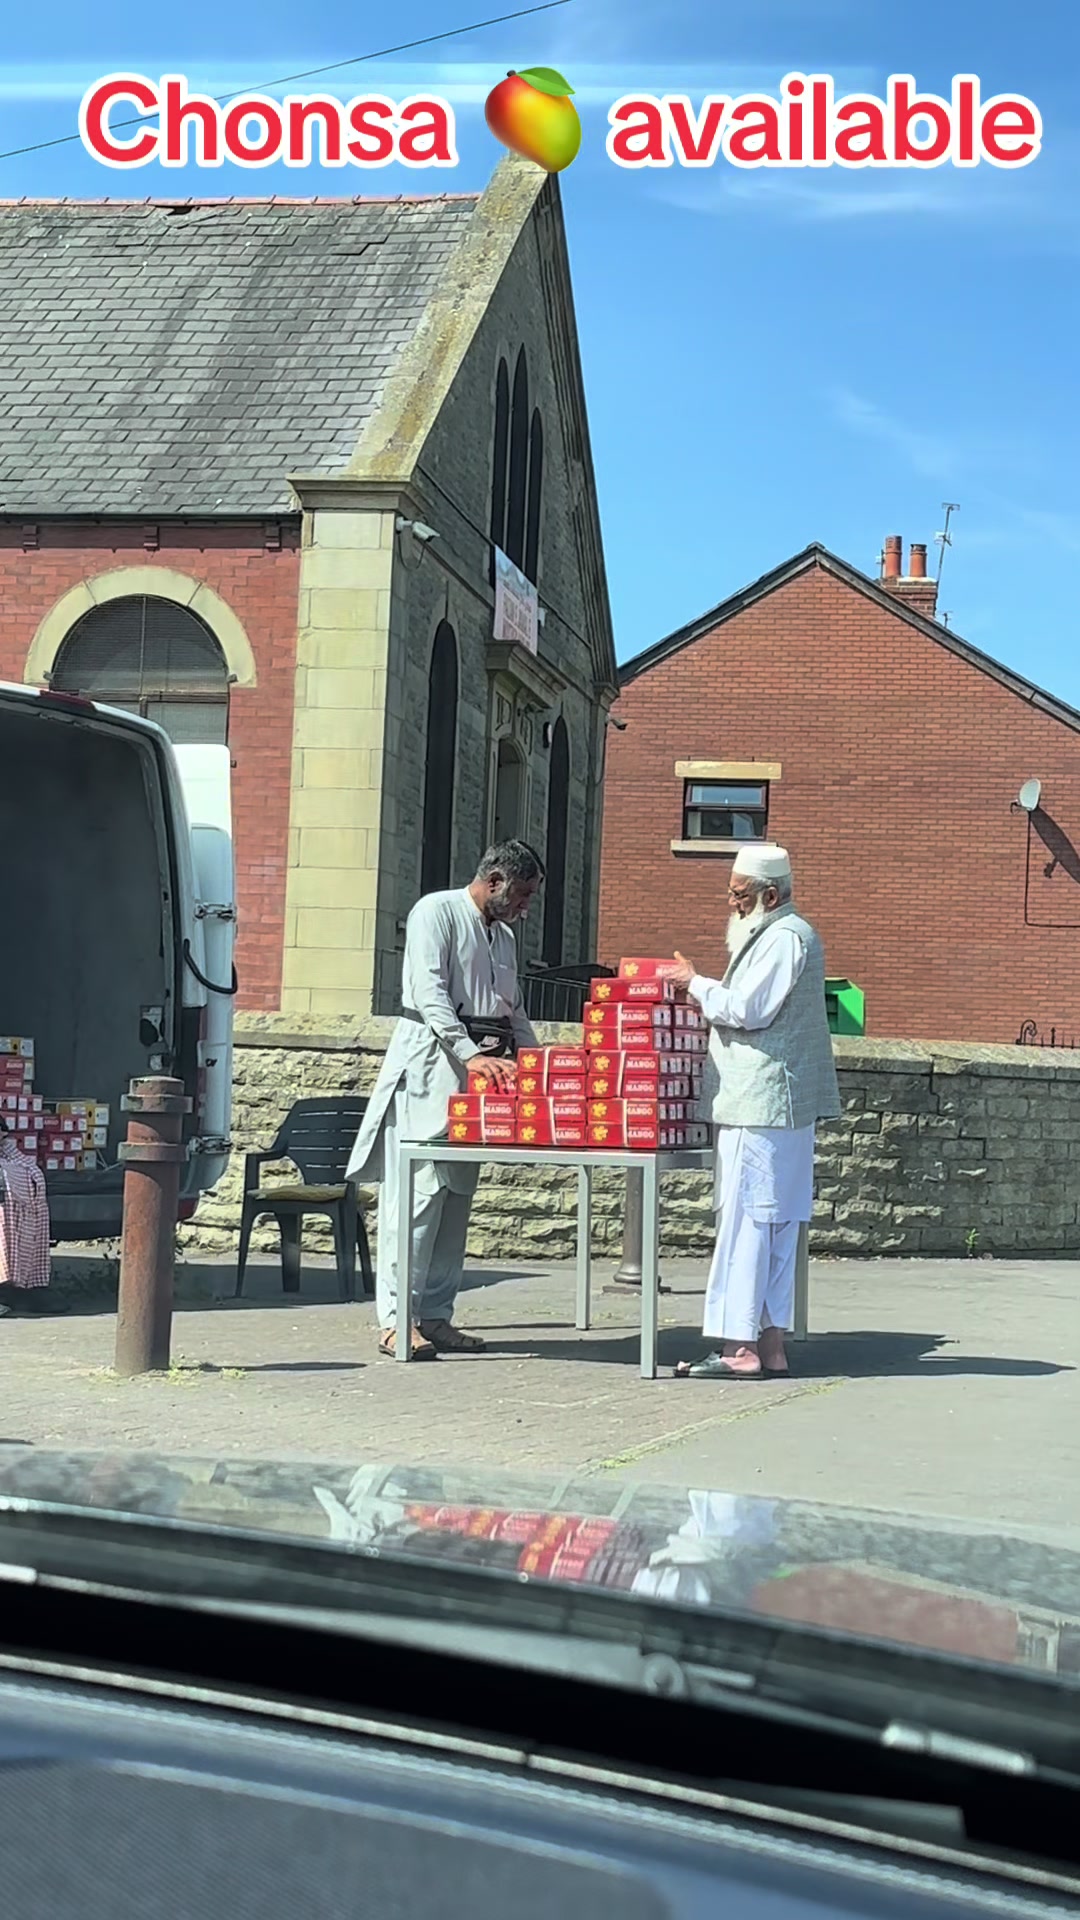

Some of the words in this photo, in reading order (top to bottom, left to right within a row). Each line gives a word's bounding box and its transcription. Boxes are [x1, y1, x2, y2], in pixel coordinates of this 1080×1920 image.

[628, 986, 659, 995] MANGO
[620, 1013, 649, 1021] MANGO
[553, 1059, 583, 1067] MANGO
[626, 1060, 656, 1069] MANGO
[552, 1082, 582, 1091] MANGO
[625, 1084, 655, 1092] MANGO
